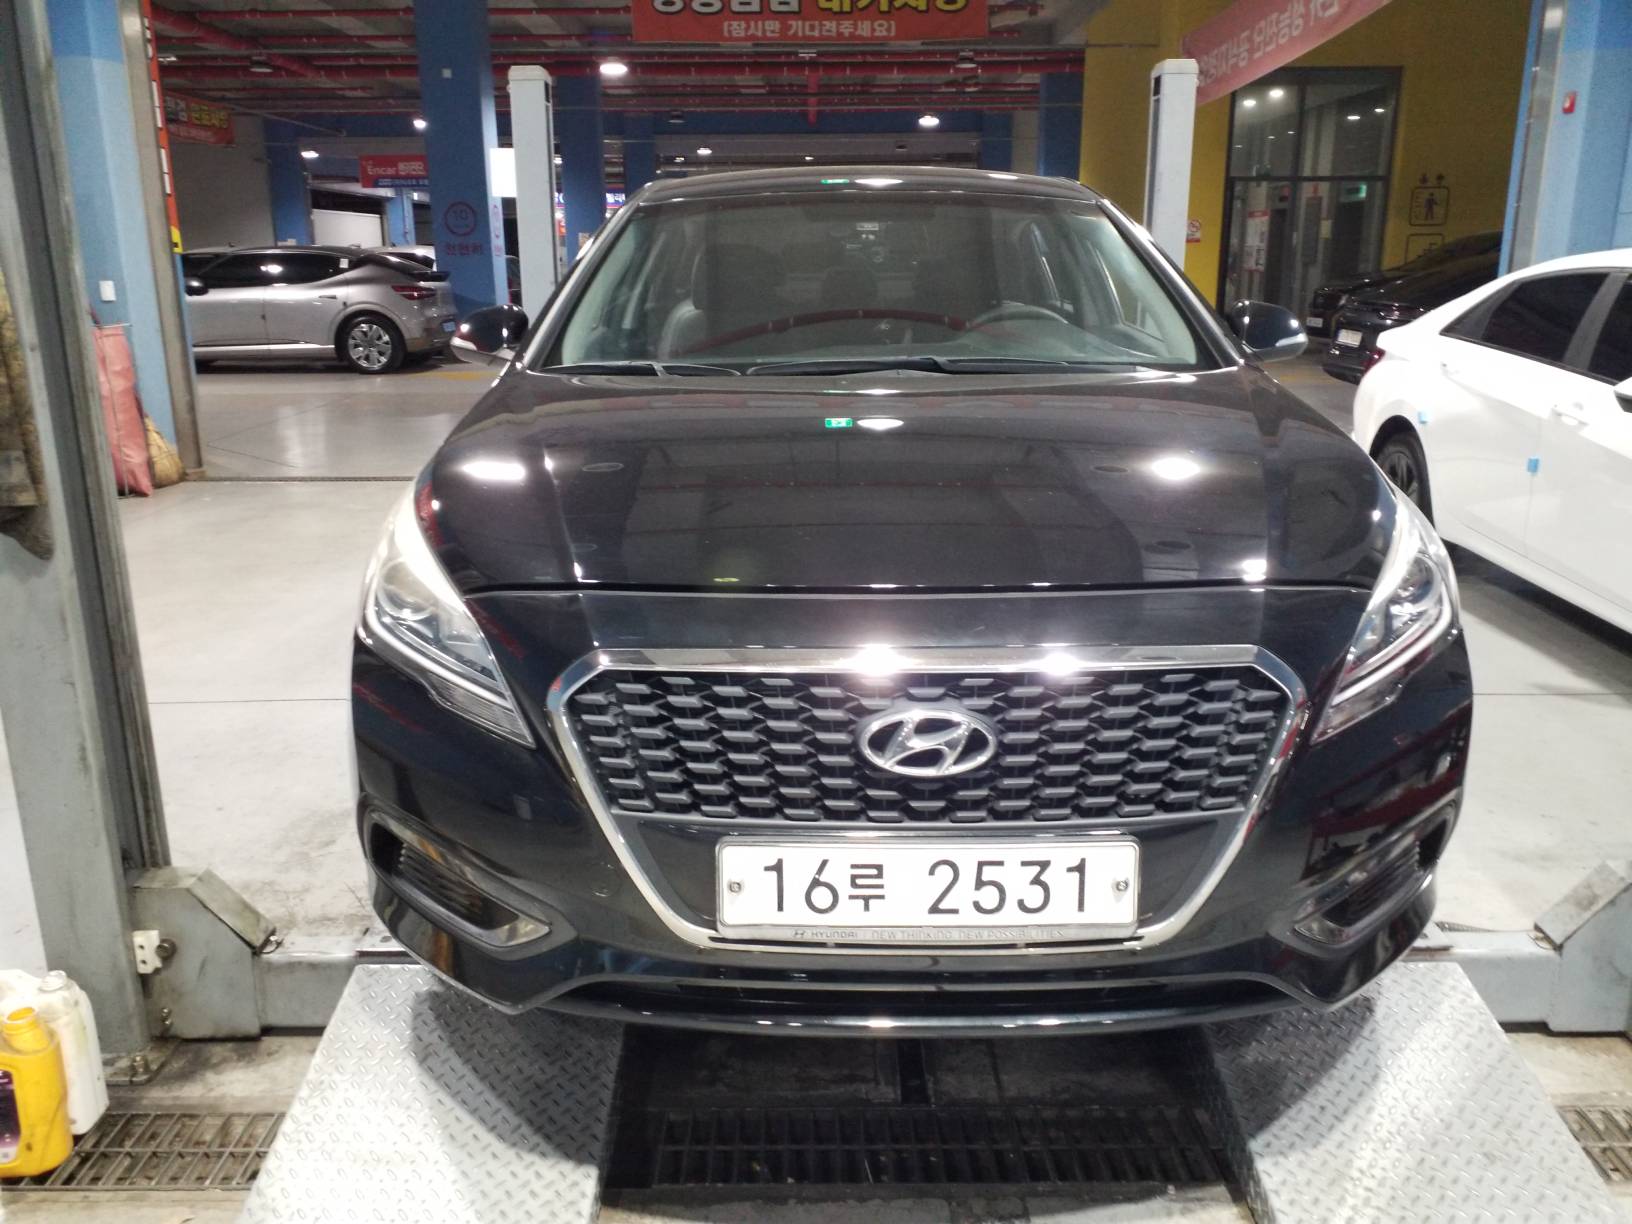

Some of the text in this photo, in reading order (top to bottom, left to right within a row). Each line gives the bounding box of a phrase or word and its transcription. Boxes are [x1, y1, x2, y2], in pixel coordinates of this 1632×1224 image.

[764, 857, 1087, 915] 16루 2531
[811, 930, 858, 939] HYUNDAI
